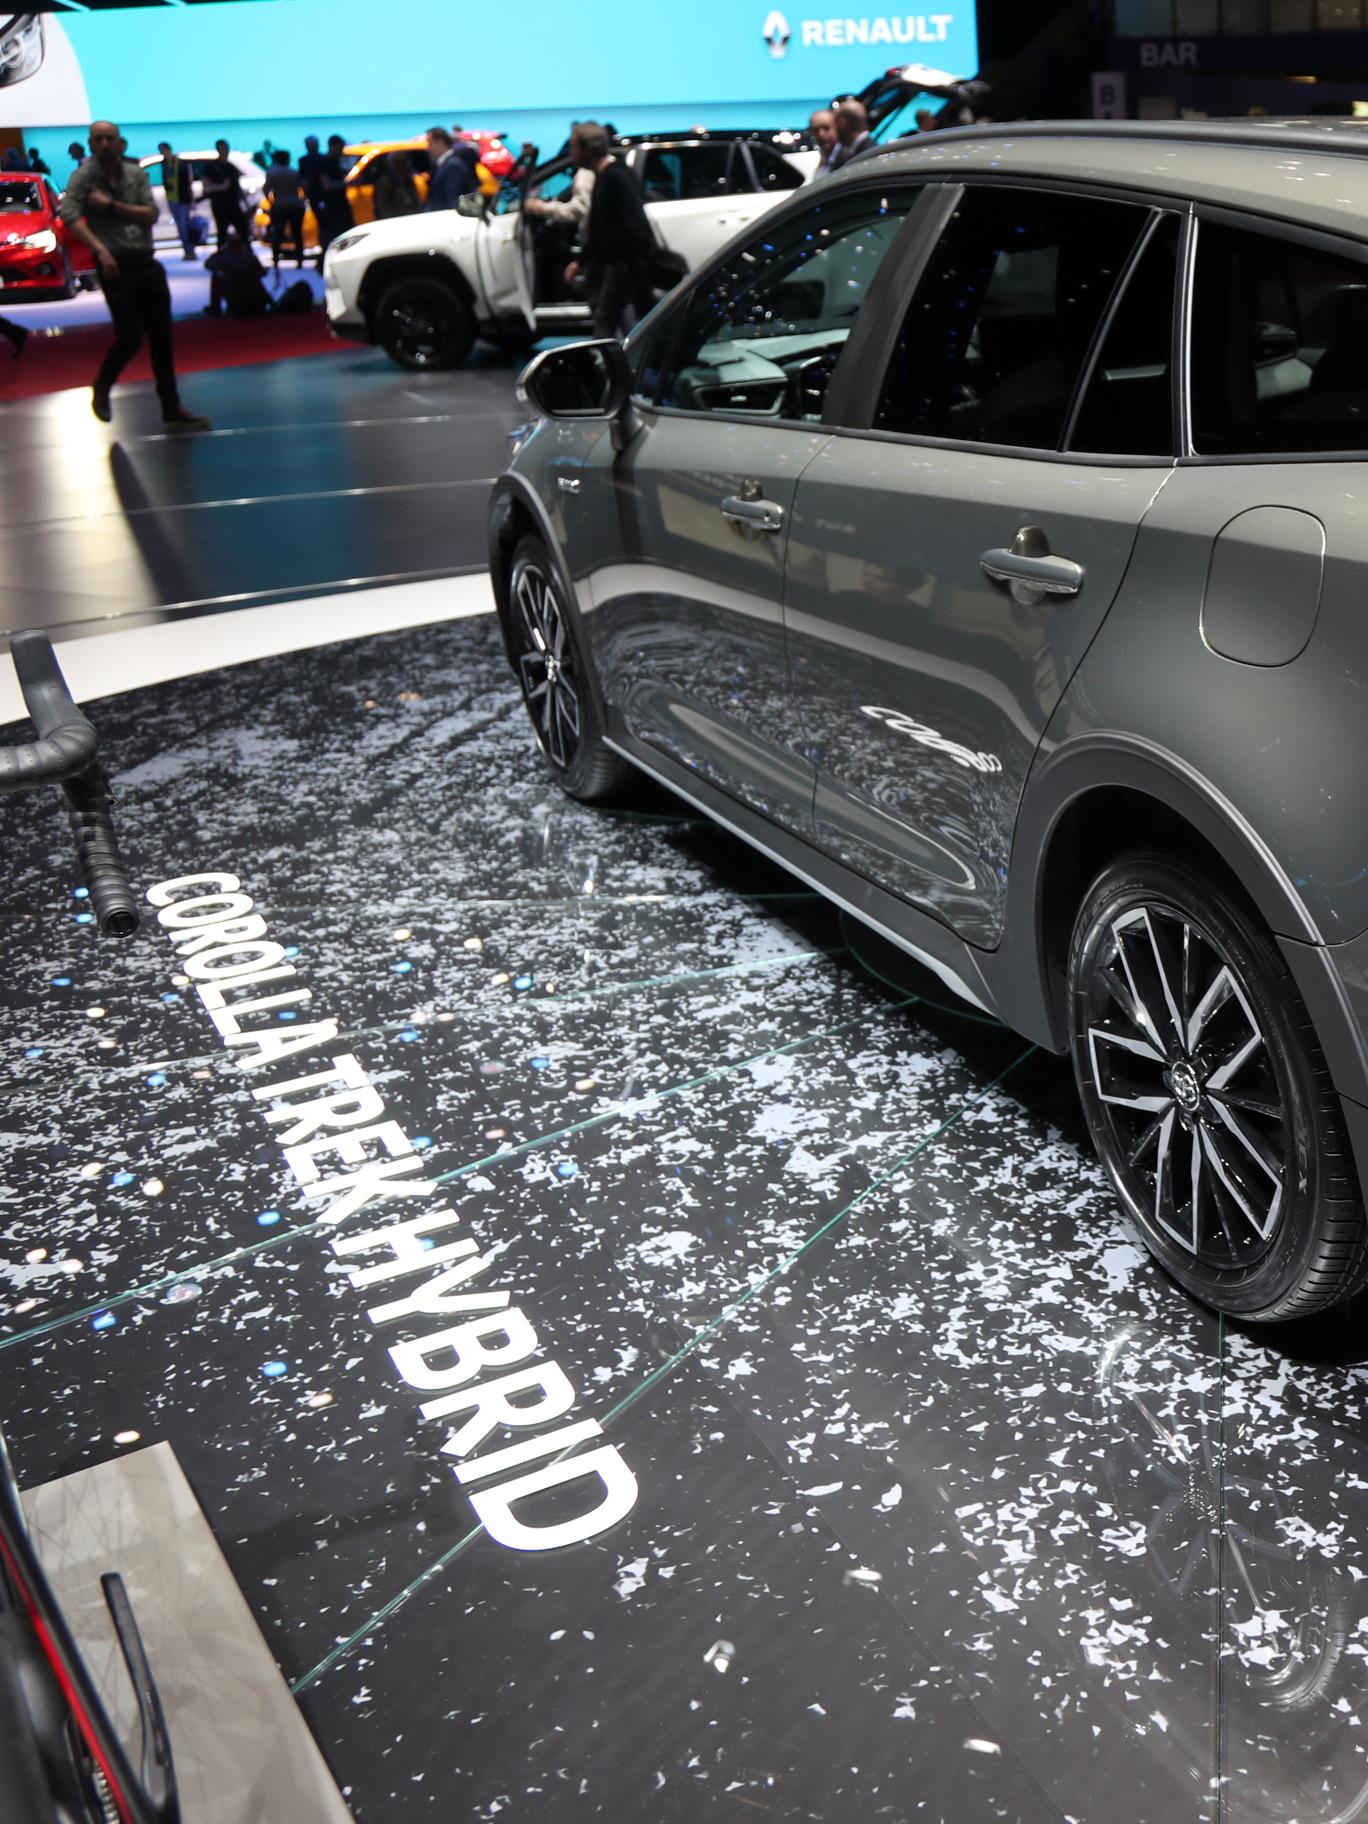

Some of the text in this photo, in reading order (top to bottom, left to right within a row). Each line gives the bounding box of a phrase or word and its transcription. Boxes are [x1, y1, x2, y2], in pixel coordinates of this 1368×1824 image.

[801, 14, 953, 47] RENAULT
[1140, 41, 1198, 67] BAR
[146, 871, 640, 1552] COROLLA TREK HYBRID
